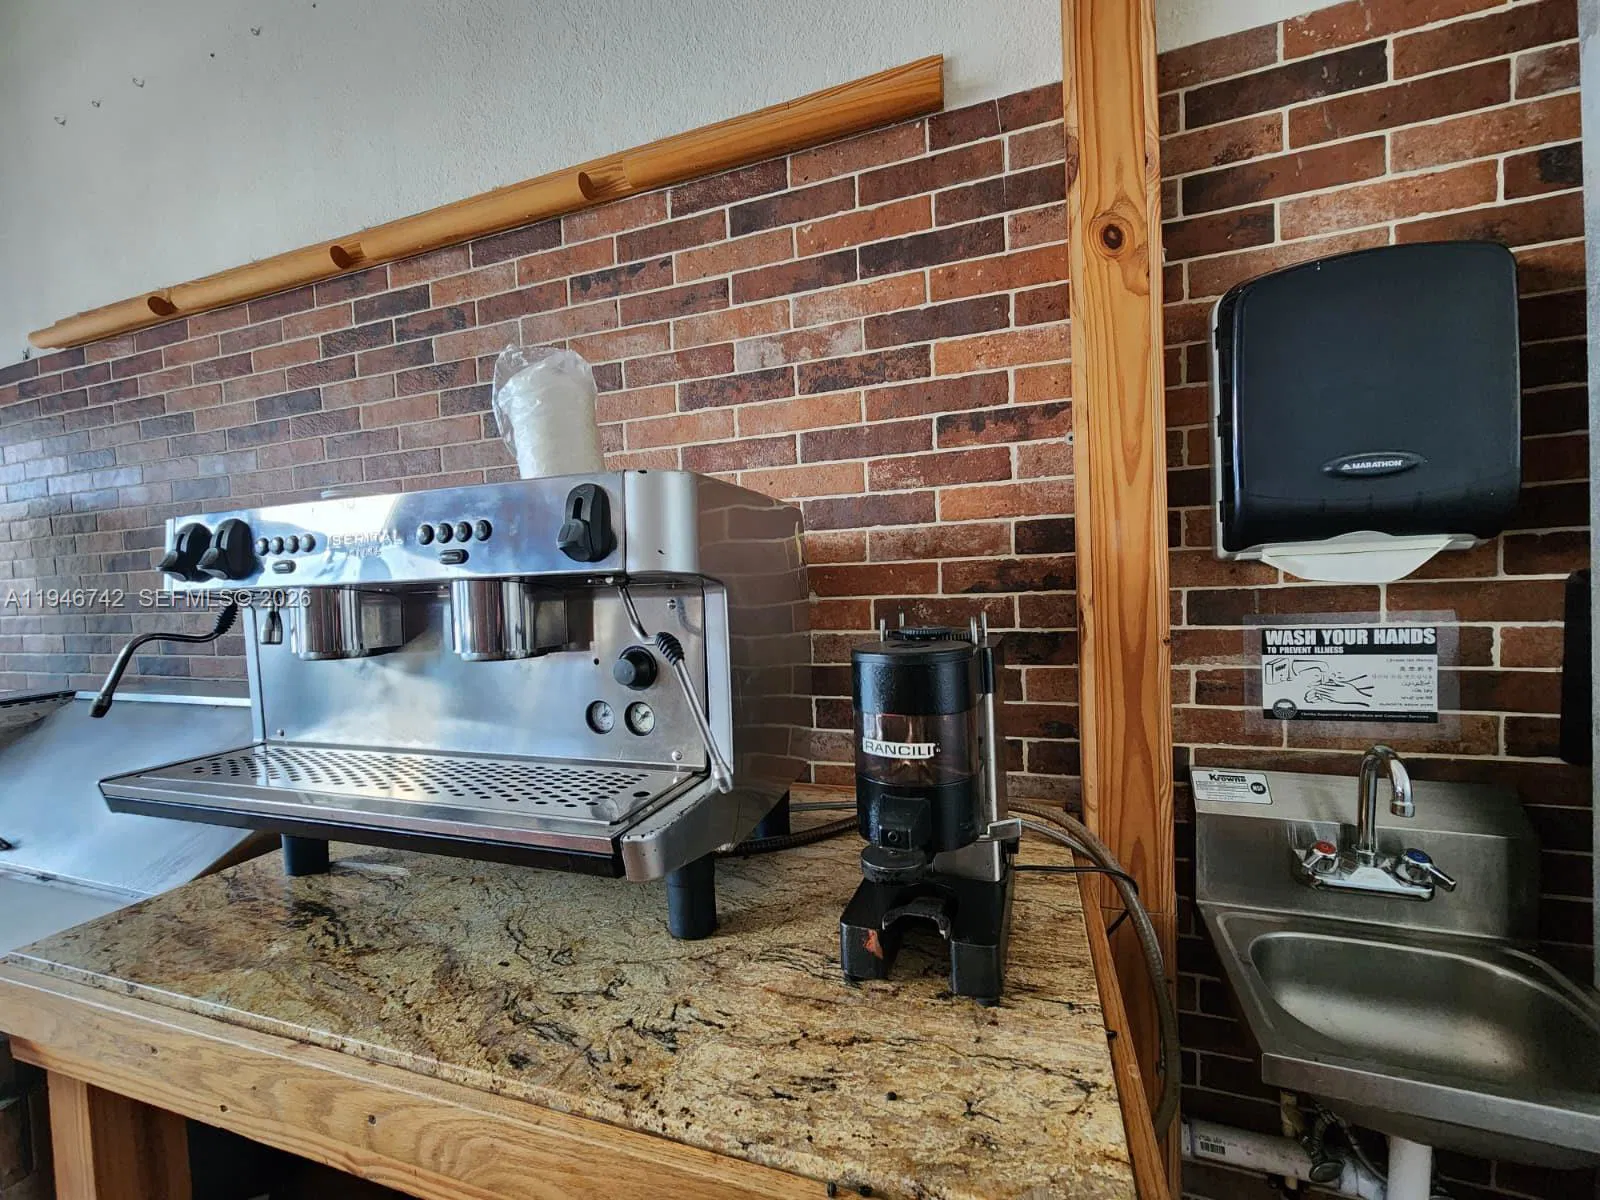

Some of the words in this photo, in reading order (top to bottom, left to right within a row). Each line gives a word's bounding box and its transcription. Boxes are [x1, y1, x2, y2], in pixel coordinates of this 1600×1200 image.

[1352, 460, 1403, 469] MARATHON
[1265, 630, 1317, 646] WASH
[1321, 629, 1369, 645] YOUR
[1373, 628, 1436, 645] HANDS
[1267, 646, 1278, 654] TO
[1279, 646, 1312, 654] PREVENT
[1314, 646, 1345, 654] ILLNESS
[865, 741, 931, 756] RANCILI
[1209, 774, 1246, 782] Krowne
